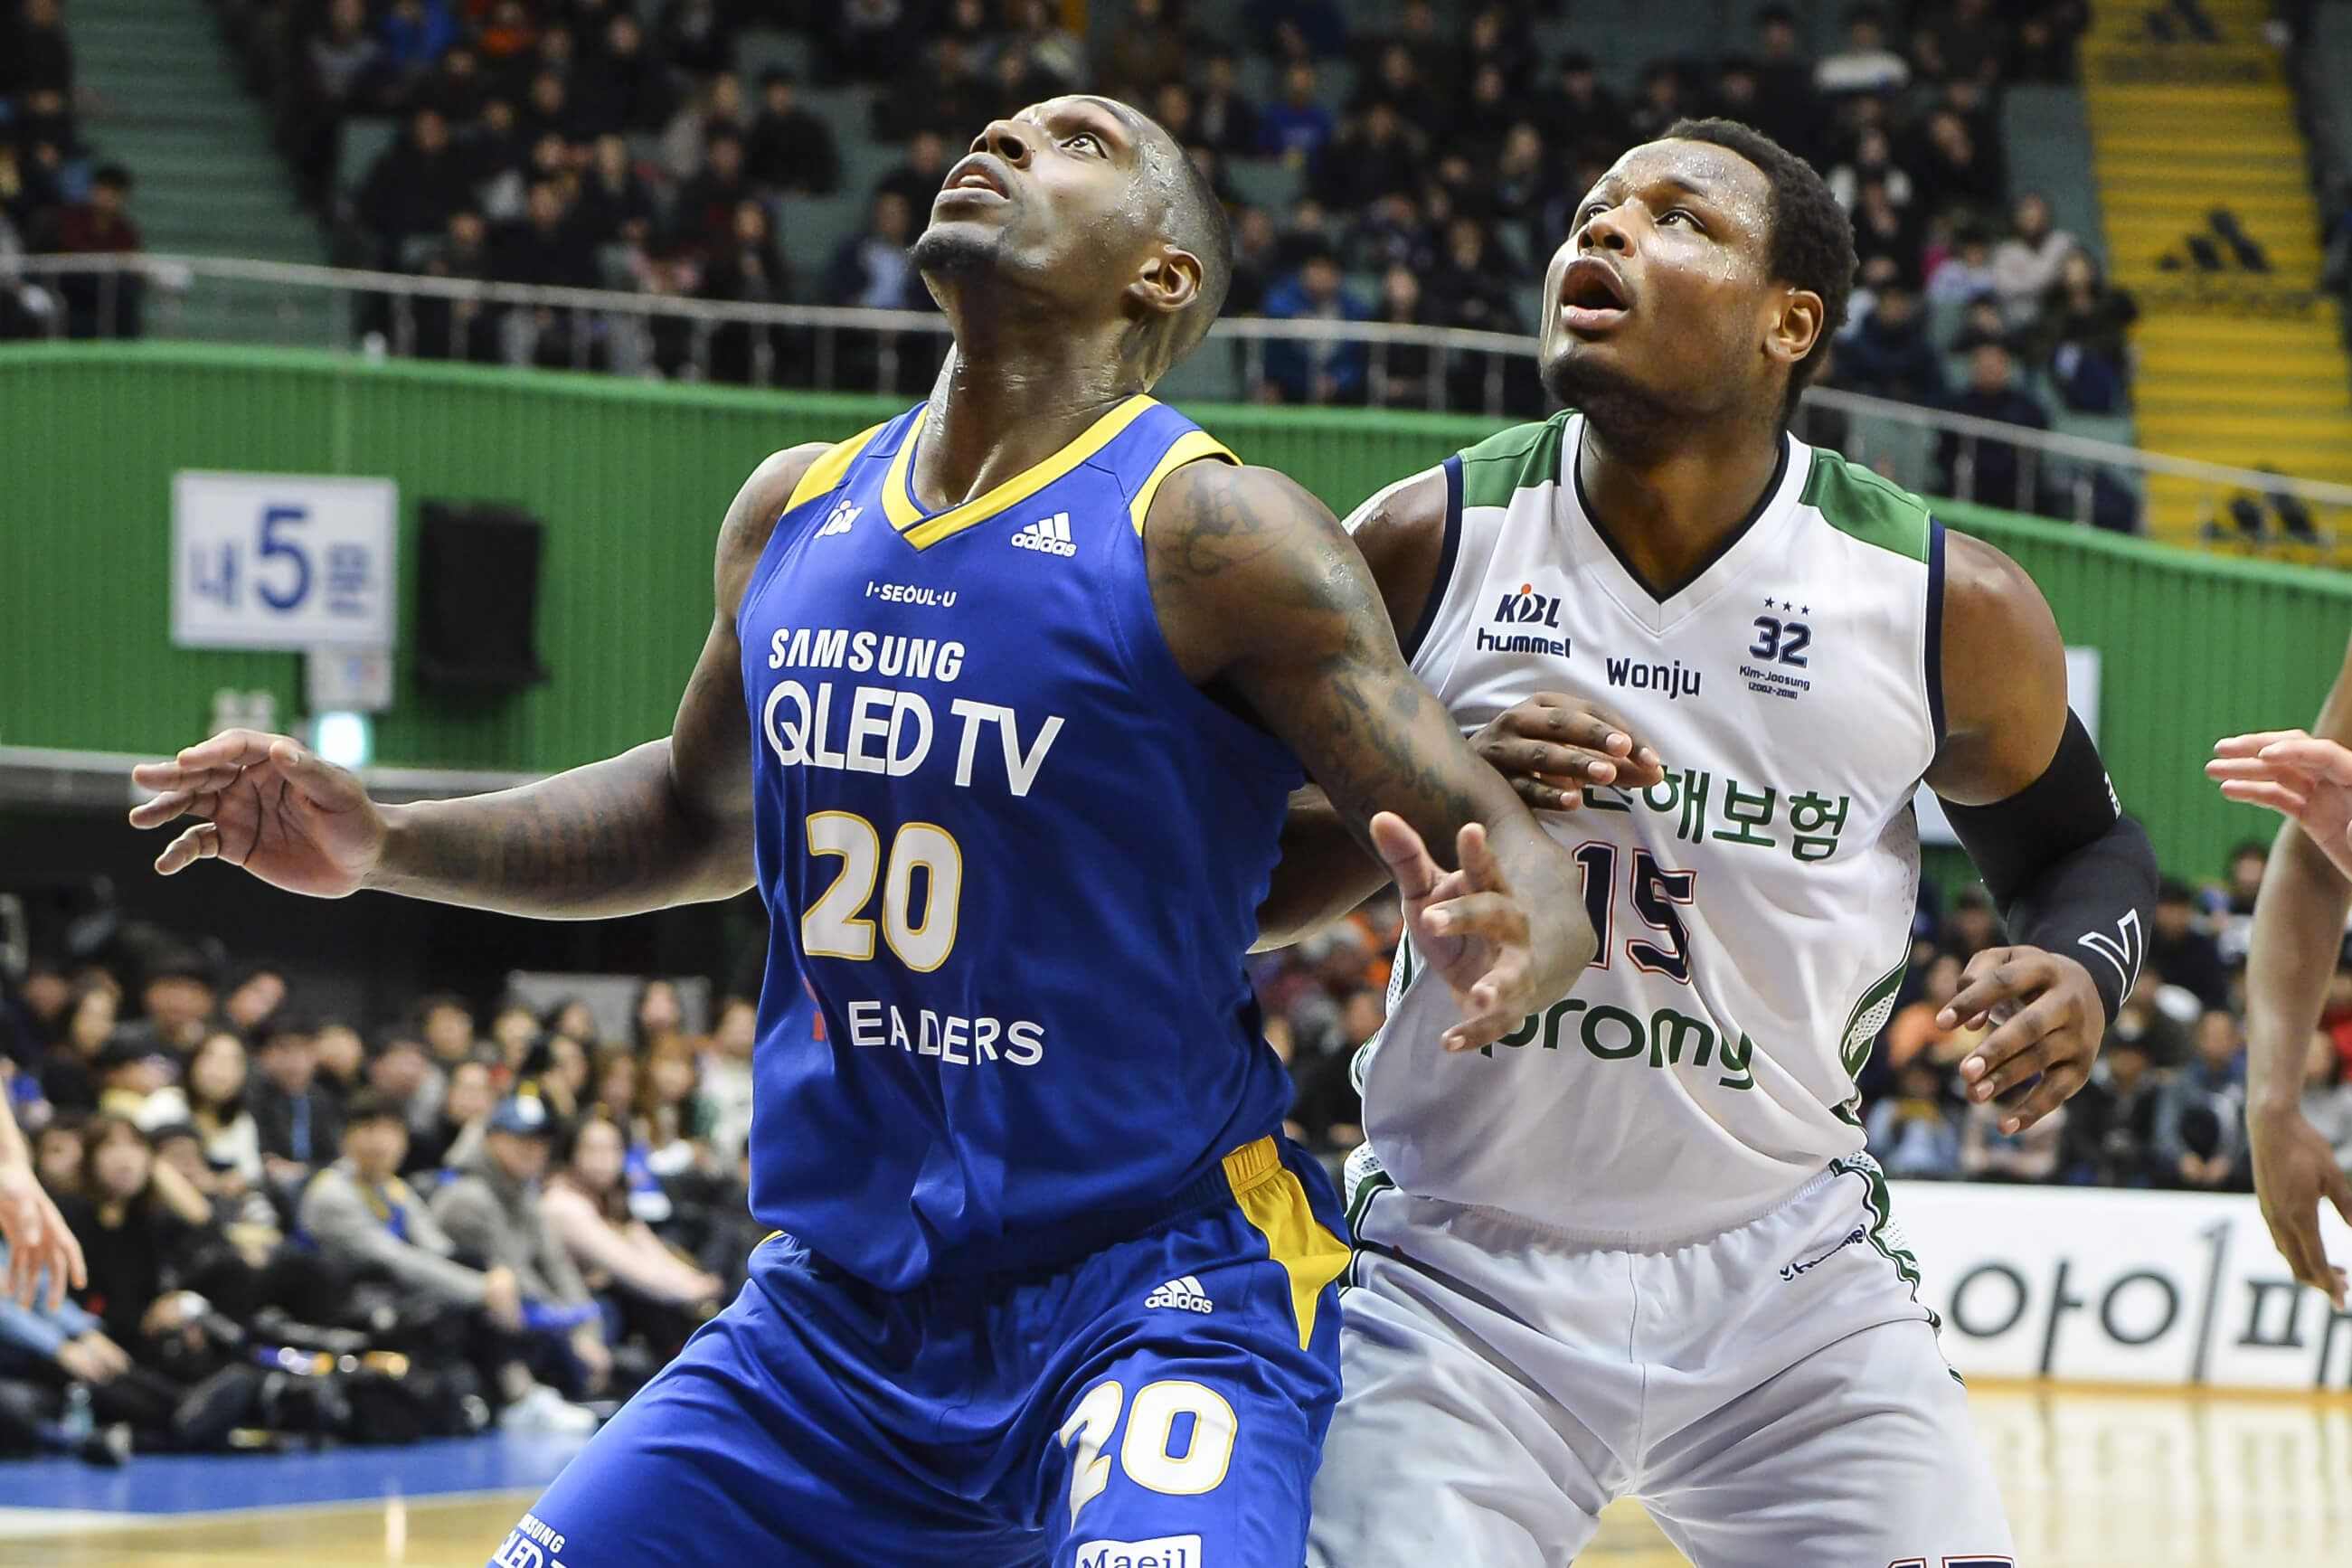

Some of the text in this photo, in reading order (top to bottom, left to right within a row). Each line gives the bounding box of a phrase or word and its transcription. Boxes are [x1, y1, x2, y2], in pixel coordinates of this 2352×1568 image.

[1011, 530, 1077, 558] adidas
[768, 628, 965, 683] SAMSUNG
[1476, 628, 1571, 658] hummel
[1749, 615, 1812, 669] 32
[1605, 656, 1702, 701] Wonju
[763, 679, 1065, 797] QLED TV
[801, 810, 962, 973] 20
[1572, 839, 1697, 986] 15
[812, 1000, 1045, 1065] EADERS
[1145, 1292, 1214, 1314] adidas
[1059, 1380, 1238, 1535] 20
